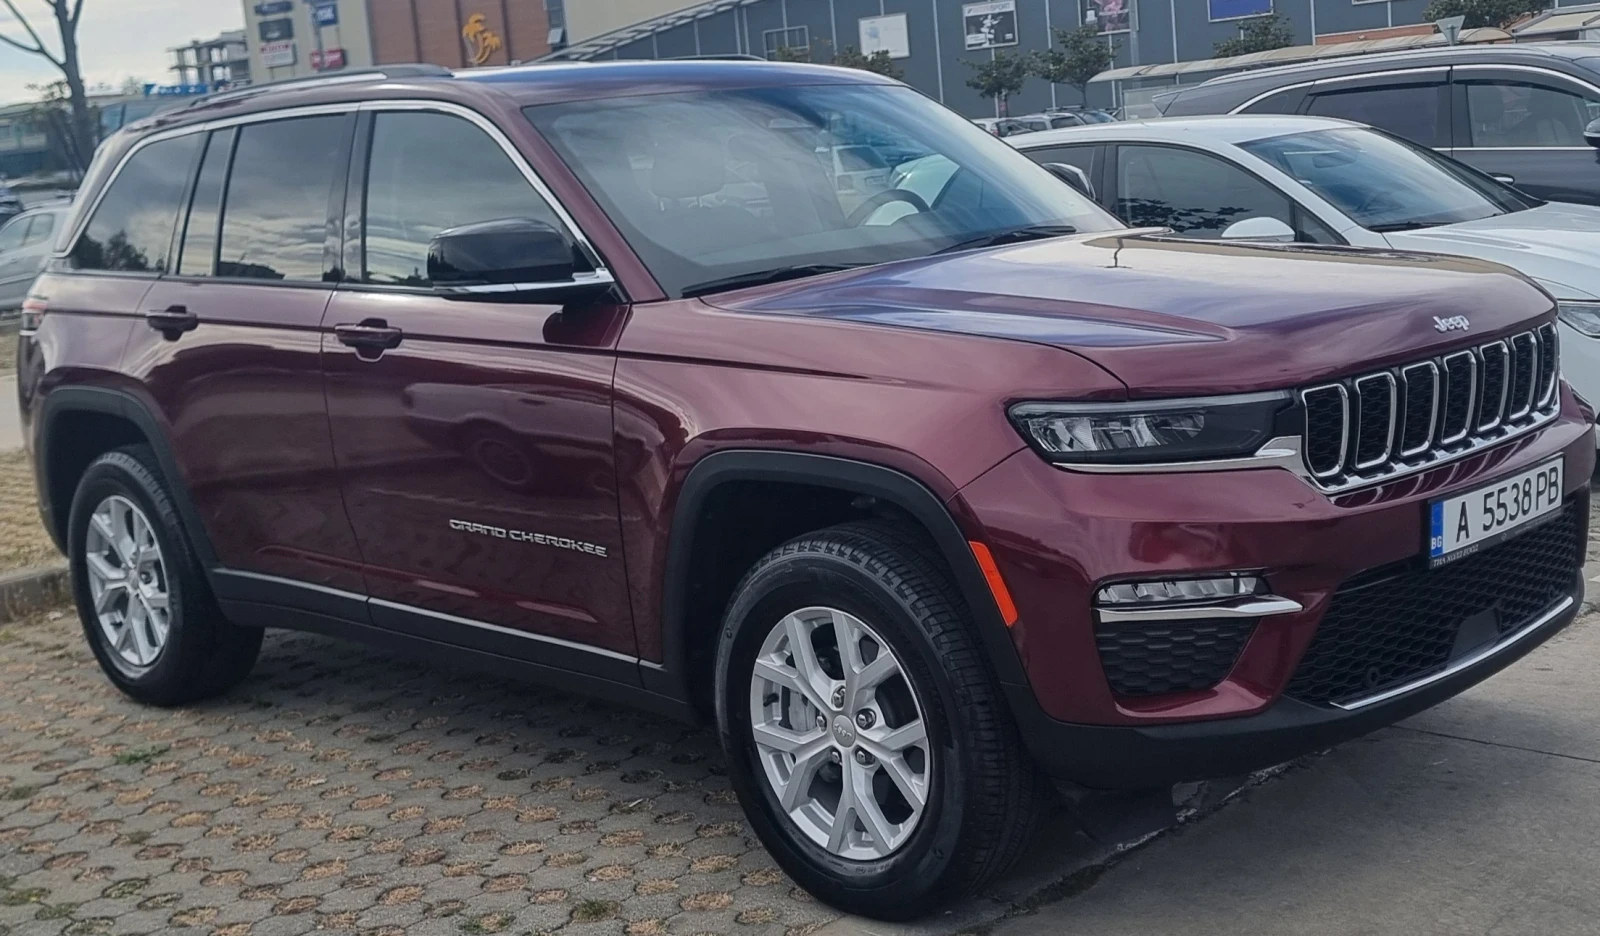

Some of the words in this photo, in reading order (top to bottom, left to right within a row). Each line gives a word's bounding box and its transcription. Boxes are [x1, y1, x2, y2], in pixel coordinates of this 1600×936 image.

[1432, 315, 1470, 333] Jeep
[448, 518, 507, 538] GRAND
[509, 530, 608, 557] CHEROKEE
[1431, 535, 1443, 550] BG
